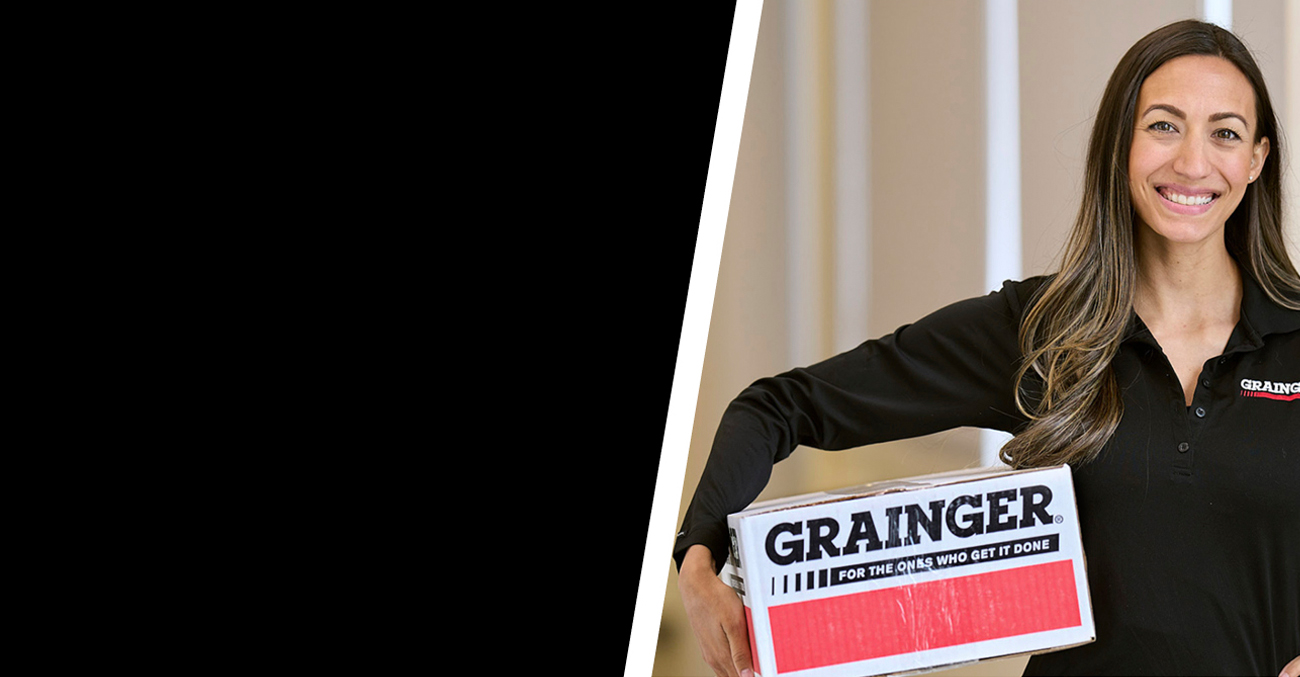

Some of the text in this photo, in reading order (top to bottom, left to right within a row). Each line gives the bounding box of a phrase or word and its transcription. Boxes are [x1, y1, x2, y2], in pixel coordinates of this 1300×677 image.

[765, 484, 1054, 567] GRAINGER
[838, 539, 1050, 582] FOR THE ONES WHO GET IT DONE
